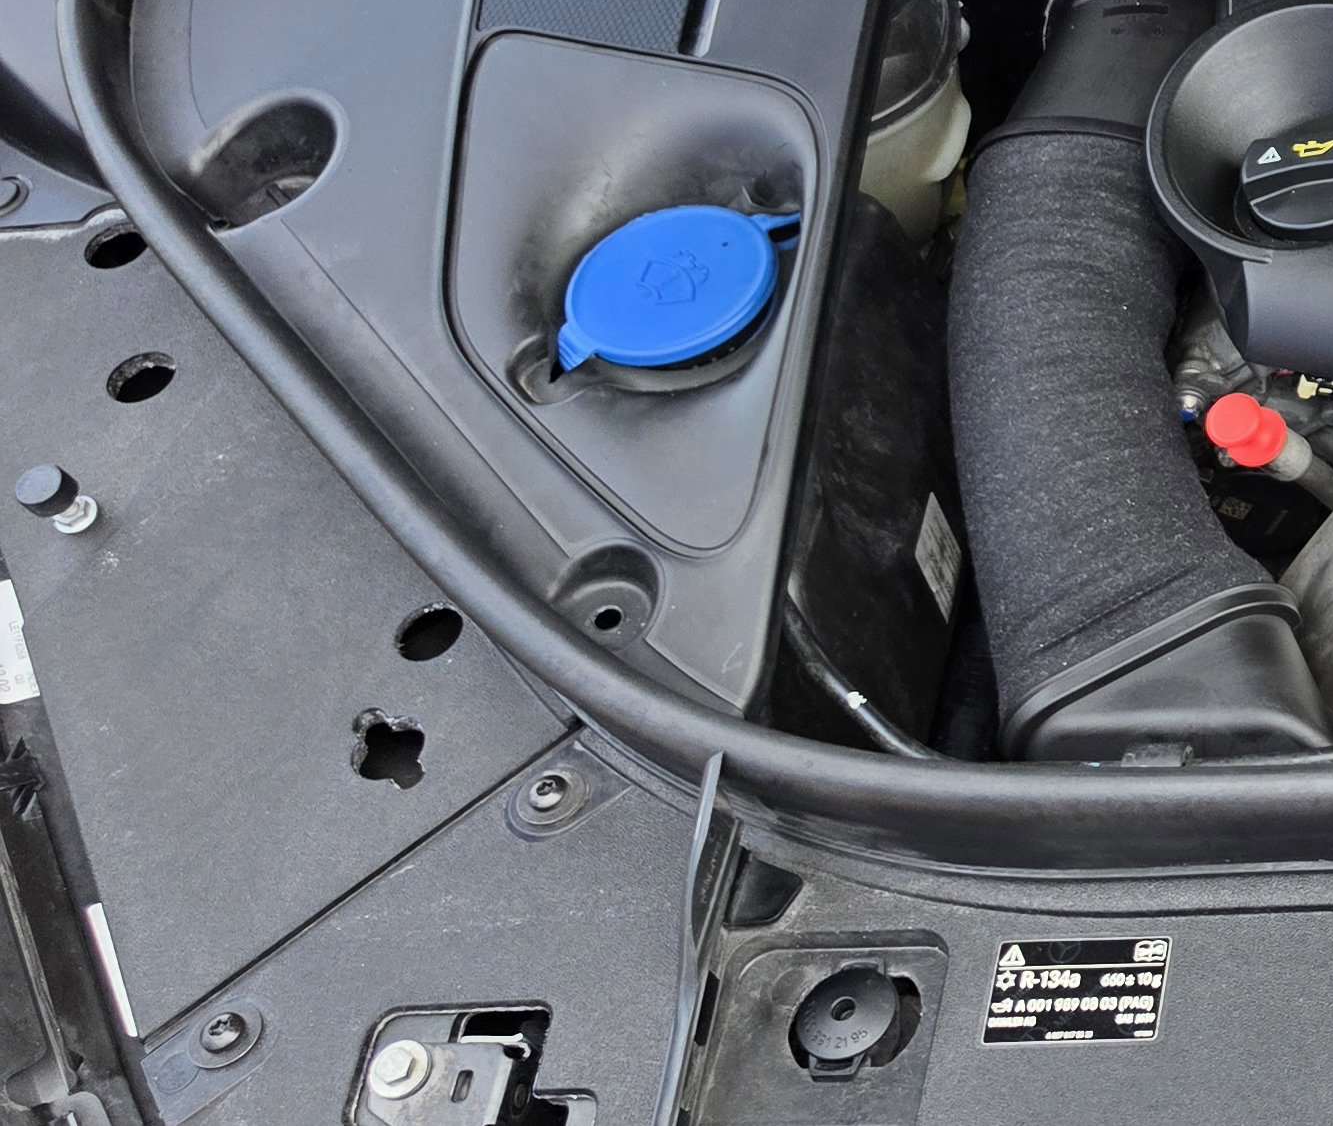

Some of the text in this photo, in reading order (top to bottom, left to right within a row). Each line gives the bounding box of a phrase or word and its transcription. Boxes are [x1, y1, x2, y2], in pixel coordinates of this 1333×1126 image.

[1019, 970, 1082, 989] R-134a
[1014, 999, 1025, 1013] A
[1027, 998, 1052, 1013] 001
[1100, 996, 1118, 1011] 03
[1118, 996, 1154, 1011] (PAG)
[834, 1036, 849, 1049] 21
[850, 1028, 869, 1044] 95
